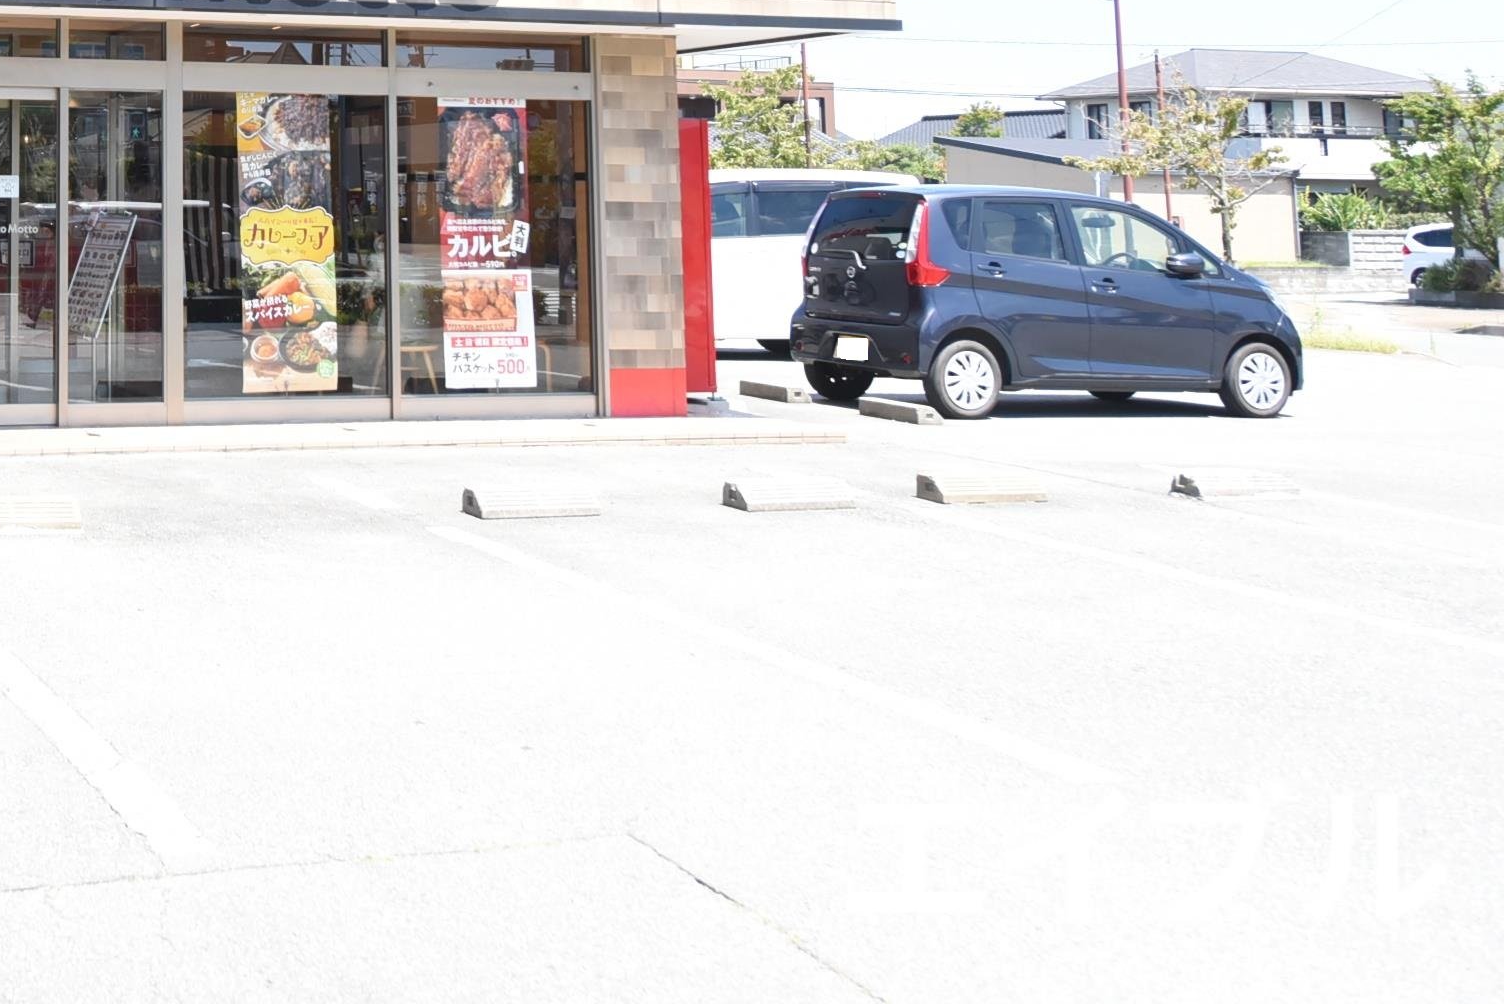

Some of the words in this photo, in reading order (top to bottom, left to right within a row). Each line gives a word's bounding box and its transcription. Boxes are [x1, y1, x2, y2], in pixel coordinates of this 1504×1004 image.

[7, 223, 39, 234] Motto
[243, 222, 329, 250] カレーフェア
[245, 304, 311, 322] スパイスカレー
[452, 351, 481, 362] チキン
[497, 359, 525, 374] 500
